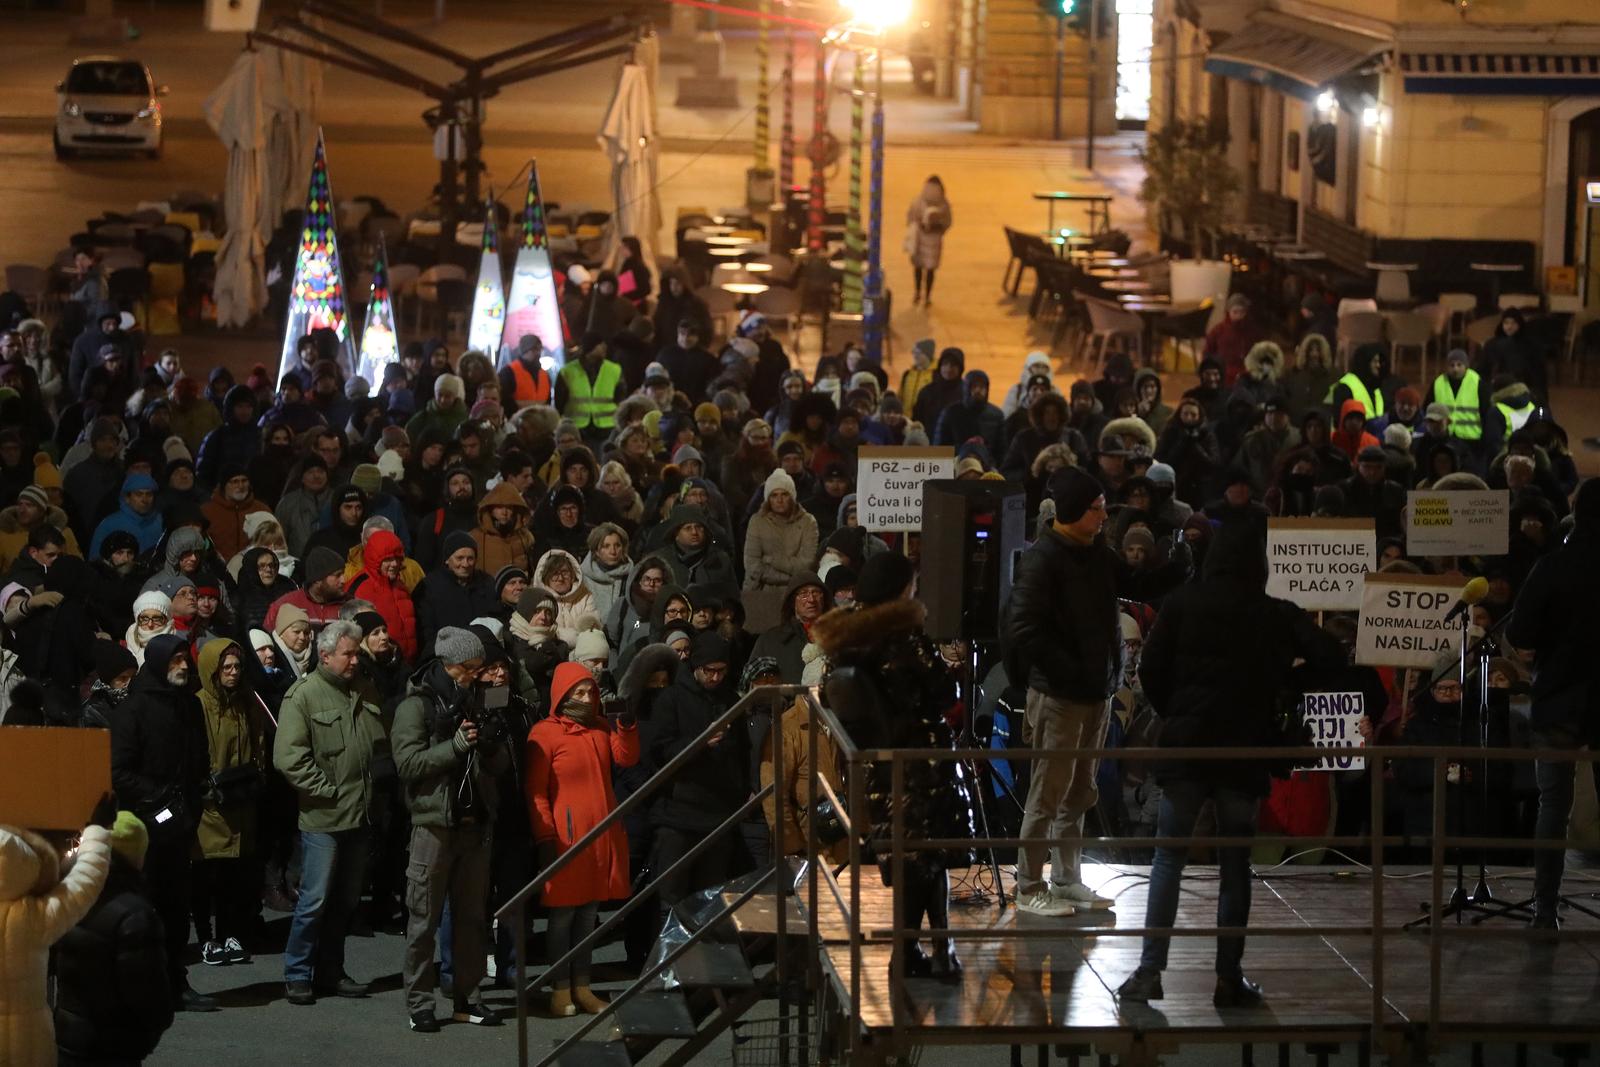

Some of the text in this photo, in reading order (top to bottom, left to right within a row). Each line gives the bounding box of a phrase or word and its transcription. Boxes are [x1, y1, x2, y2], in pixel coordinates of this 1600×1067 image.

[914, 462, 925, 473] di
[928, 462, 940, 475] je
[867, 493, 899, 507] Čuva
[903, 496, 911, 507] li
[1415, 508, 1449, 516] NOGOM
[868, 513, 921, 526] il galebo
[1413, 518, 1453, 526] U GLAVU
[1273, 544, 1369, 557] INSTITUCIJE,
[1273, 563, 1370, 574] TKO TU KOGA
[1289, 577, 1341, 592] PLAĆA
[1386, 590, 1450, 610] STOP
[1375, 635, 1451, 652] NASILJA
